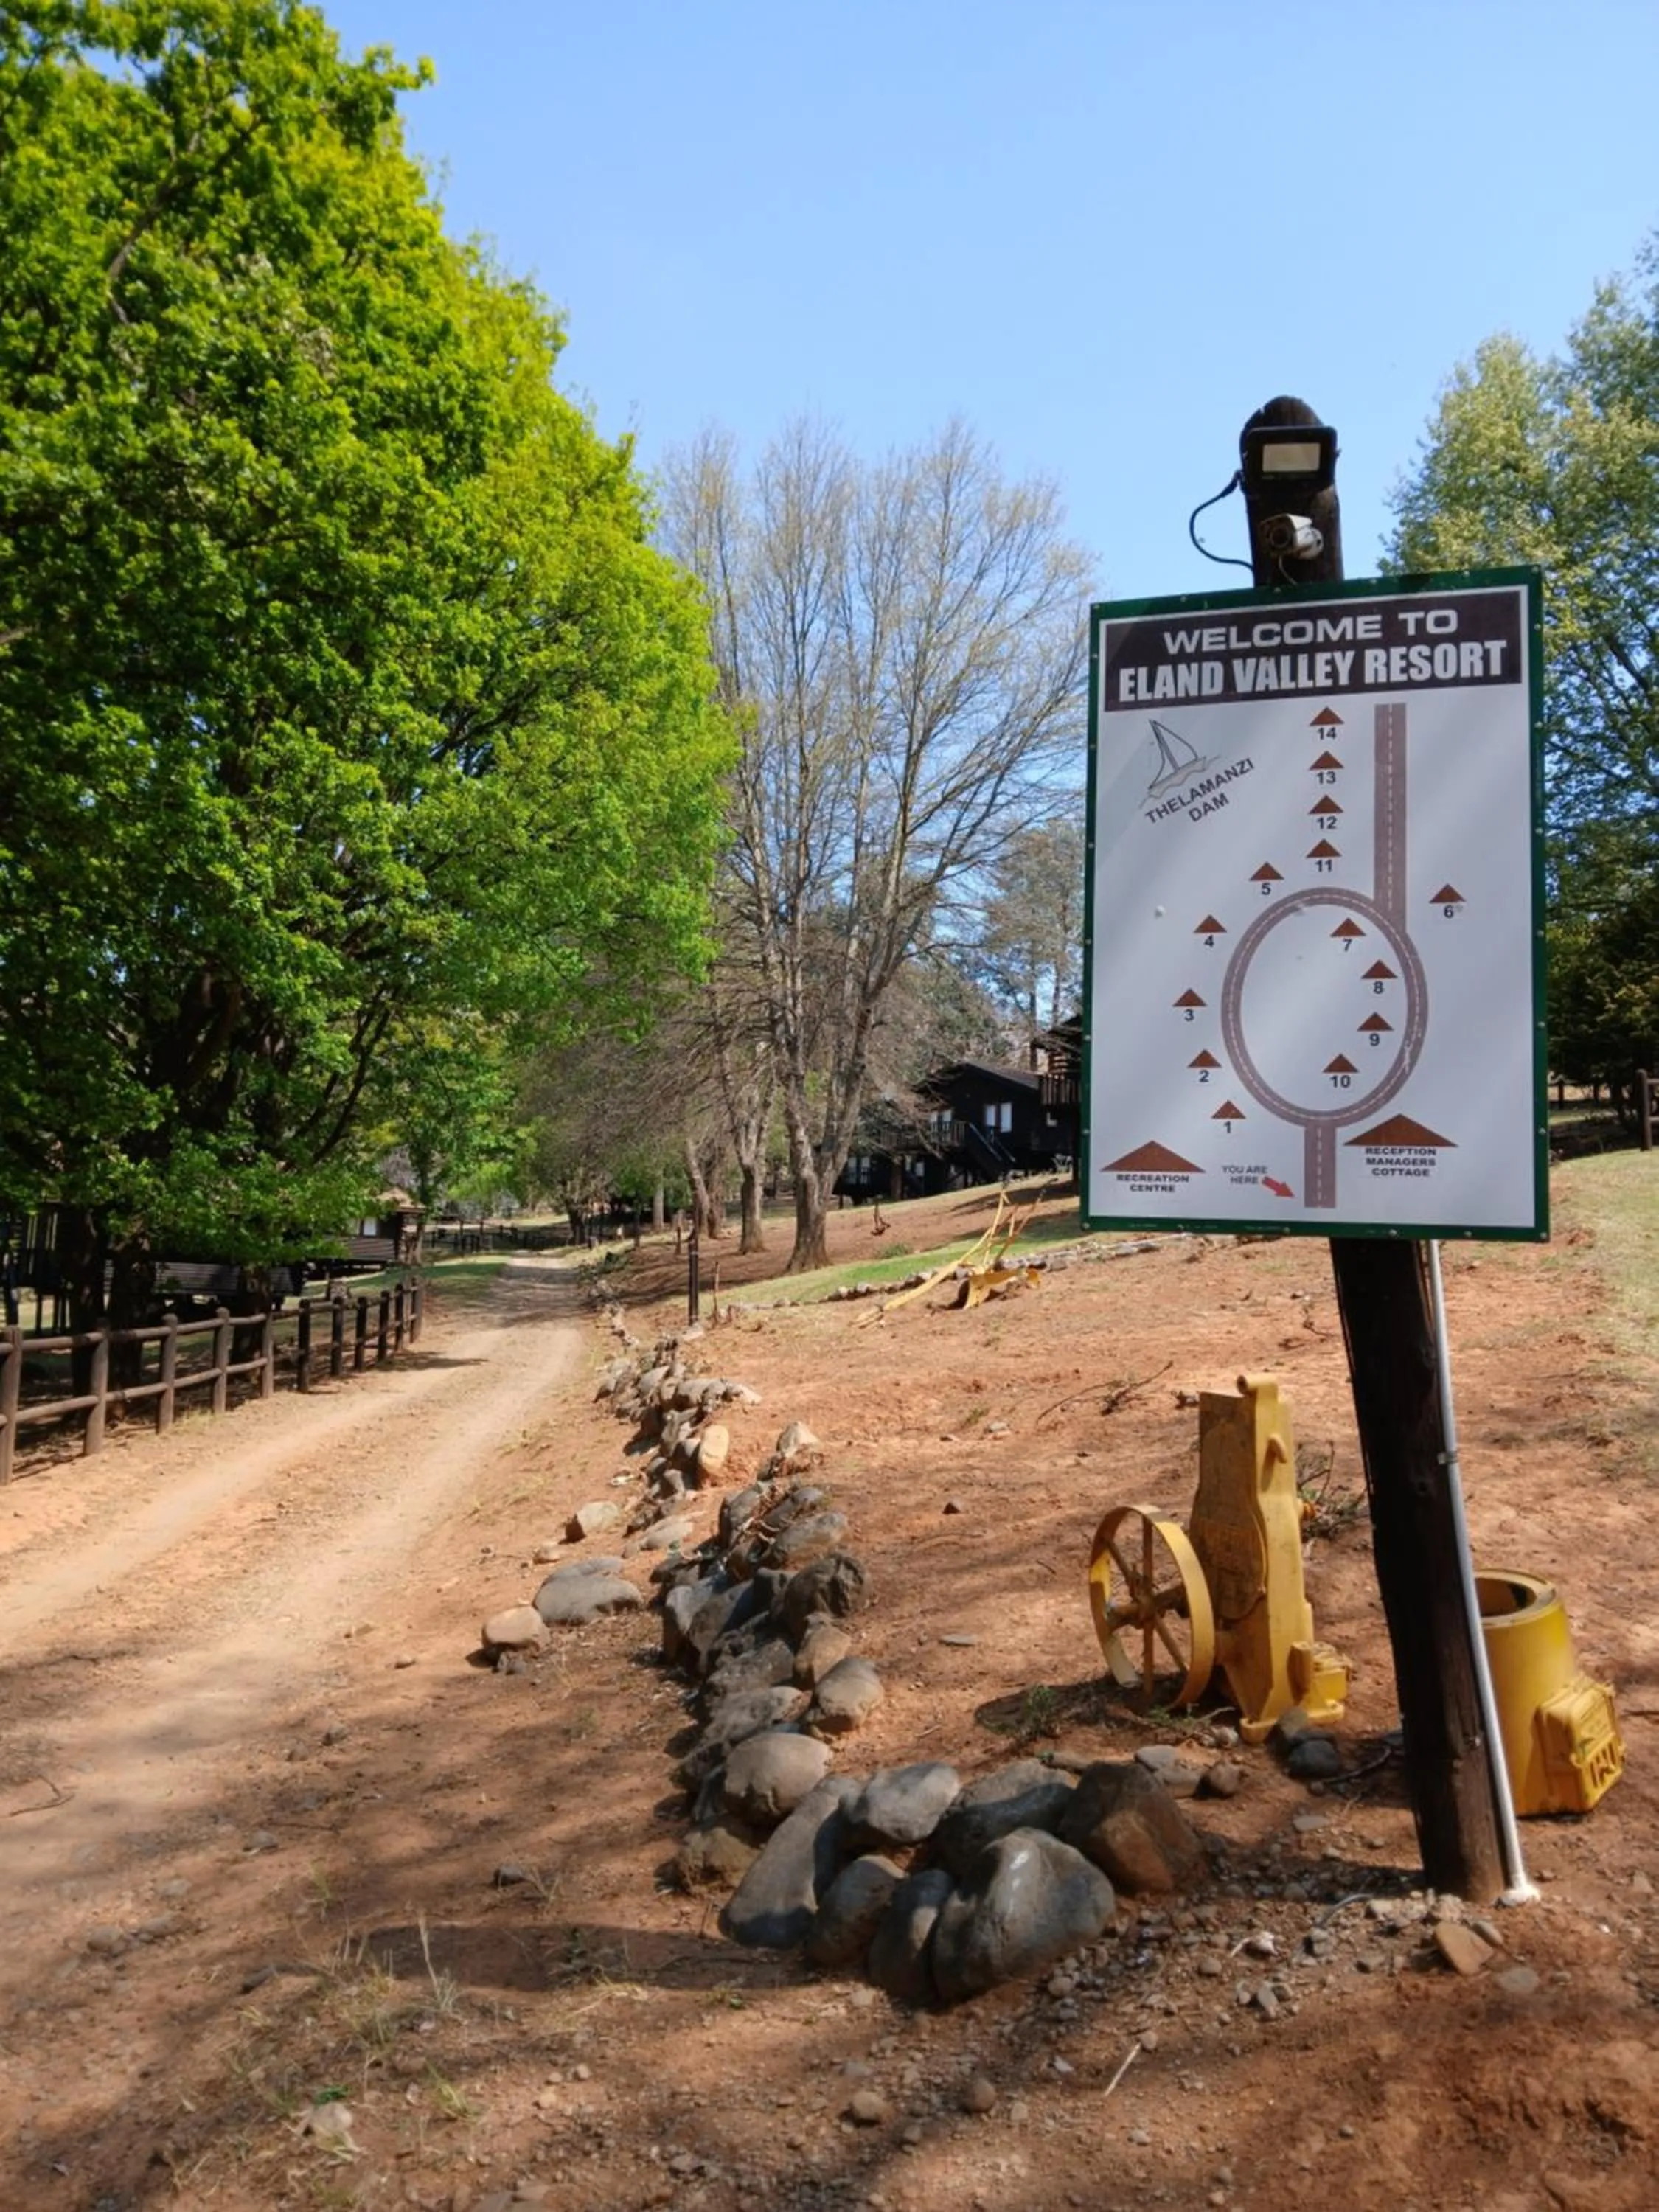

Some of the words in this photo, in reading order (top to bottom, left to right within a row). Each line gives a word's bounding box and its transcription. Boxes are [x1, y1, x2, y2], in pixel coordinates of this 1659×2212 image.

[1163, 614, 1382, 654] WELCOME
[1399, 609, 1458, 636] TO
[1119, 661, 1224, 702] ELAND
[1232, 650, 1356, 693] VALLEY
[1364, 639, 1507, 685] RESORT
[1317, 726, 1338, 740] 14
[1317, 771, 1337, 785] 13
[1144, 757, 1254, 824] THELAMANZI
[1188, 792, 1229, 822] DAM
[1317, 816, 1338, 830] 12
[1316, 859, 1332, 873] 11
[1261, 882, 1272, 896] 5
[1443, 905, 1455, 919] 6
[1203, 934, 1215, 947] 4
[1342, 938, 1353, 952] 7
[1373, 981, 1384, 995] 8
[1184, 1008, 1195, 1022] 3
[1368, 1033, 1381, 1046] 9
[1199, 1069, 1210, 1083] 2
[1330, 1074, 1352, 1088] 10
[1224, 1121, 1232, 1134] 1
[1365, 1147, 1437, 1156] RECEPTION
[1366, 1157, 1436, 1166] MANAGERS
[1222, 1165, 1245, 1174] YOU
[1245, 1166, 1268, 1174] ARE
[1371, 1167, 1430, 1177] COTTAGE
[1116, 1174, 1189, 1183] RECREATION
[1230, 1176, 1259, 1185] HERE
[1130, 1184, 1175, 1193] CENTRE
